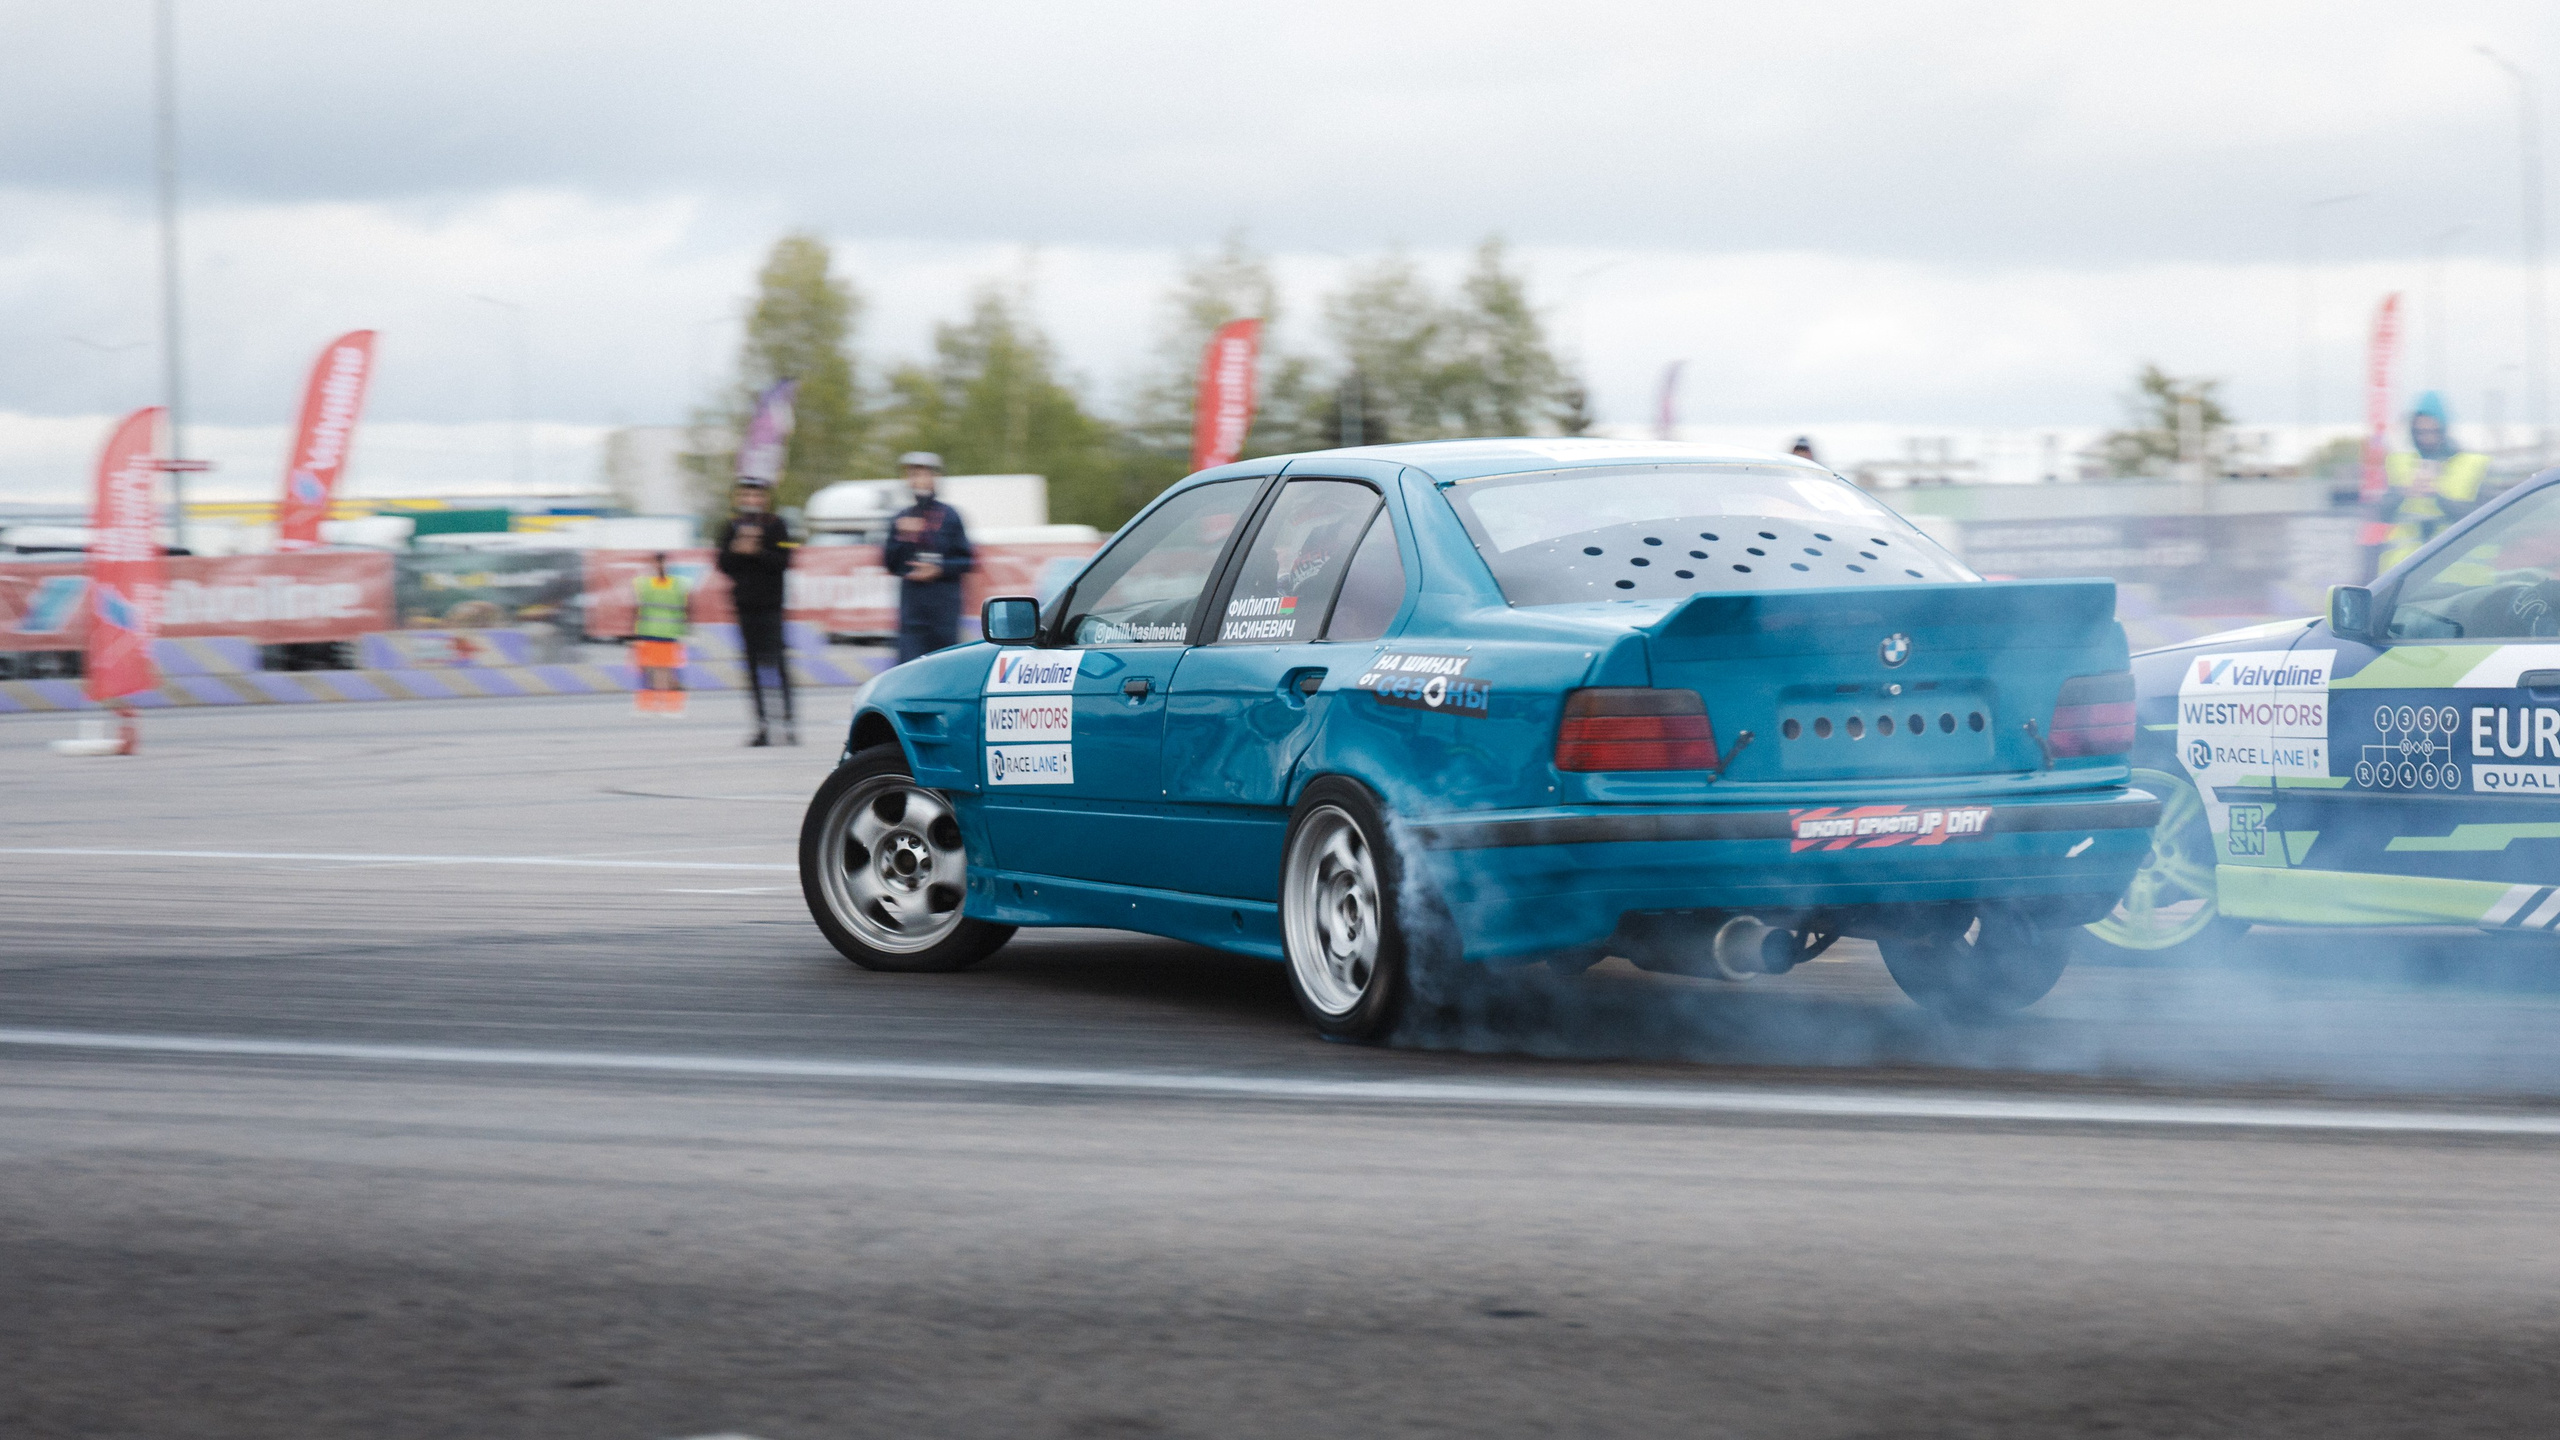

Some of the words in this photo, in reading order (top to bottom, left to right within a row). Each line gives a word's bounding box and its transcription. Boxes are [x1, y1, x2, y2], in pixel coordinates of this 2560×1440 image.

[1228, 596, 1280, 617] ФИЛИПП
[1223, 619, 1296, 640] ХАСИНЕВИЧ
[1018, 663, 1072, 685] Valvoline
[1373, 655, 1402, 670] НА
[1399, 656, 1468, 675] ШИНАХ
[2232, 665, 2323, 686] Valvoline
[989, 707, 1068, 730] WESTMOTORS
[2184, 703, 2323, 726] WESTMOTORS
[2380, 713, 2388, 726] 1
[2402, 713, 2410, 726] 3
[2423, 713, 2431, 727] 5
[2445, 714, 2453, 727] 7
[2472, 707, 2560, 757] EUR
[2216, 748, 2256, 764] RACE
[2261, 748, 2304, 766] LANE
[2402, 742, 2410, 752] N
[2424, 742, 2431, 752] N
[1007, 757, 1030, 773] RACE
[1033, 756, 1058, 772] LANE
[2361, 767, 2369, 780] R
[2383, 769, 2390, 781] 2
[2404, 769, 2412, 782] 4
[2425, 769, 2433, 783] 6
[2447, 770, 2454, 783] 8
[2484, 772, 2560, 789] QUAL
[1918, 811, 1944, 835] JP
[1944, 810, 1989, 834] DAY
